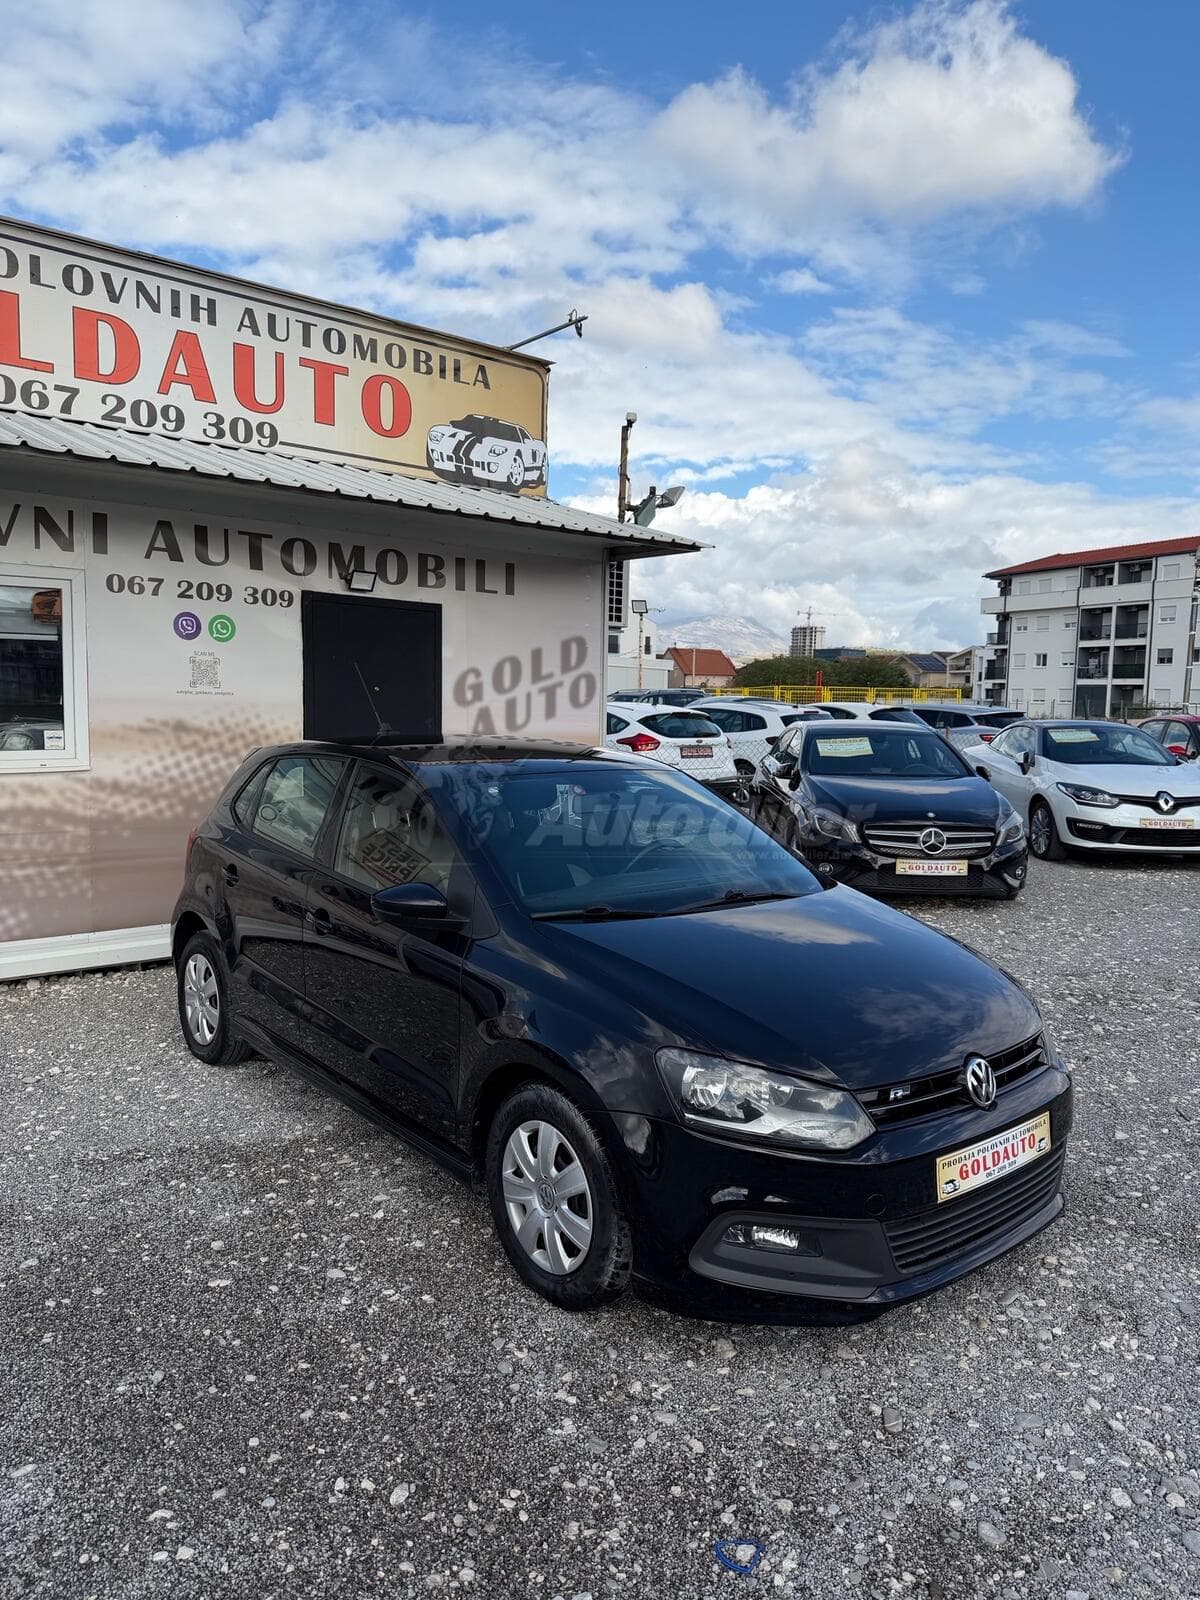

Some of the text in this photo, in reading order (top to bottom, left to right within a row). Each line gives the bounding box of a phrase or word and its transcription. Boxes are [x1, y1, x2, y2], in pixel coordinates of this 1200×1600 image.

[237, 307, 491, 390] AUTOMOBILA
[101, 393, 186, 433] 209
[202, 412, 279, 448] 309
[144, 519, 515, 596] AUTOMOBILI
[105, 573, 294, 608] 067 209 309
[453, 635, 588, 708] GOLD
[472, 671, 597, 736] AUTO
[908, 864, 958, 872] GOLDAUTO
[941, 1119, 1047, 1170] PRODAJA POLOVNIH AUTOMOBILA
[959, 1133, 1037, 1181] GOLDAUTO
